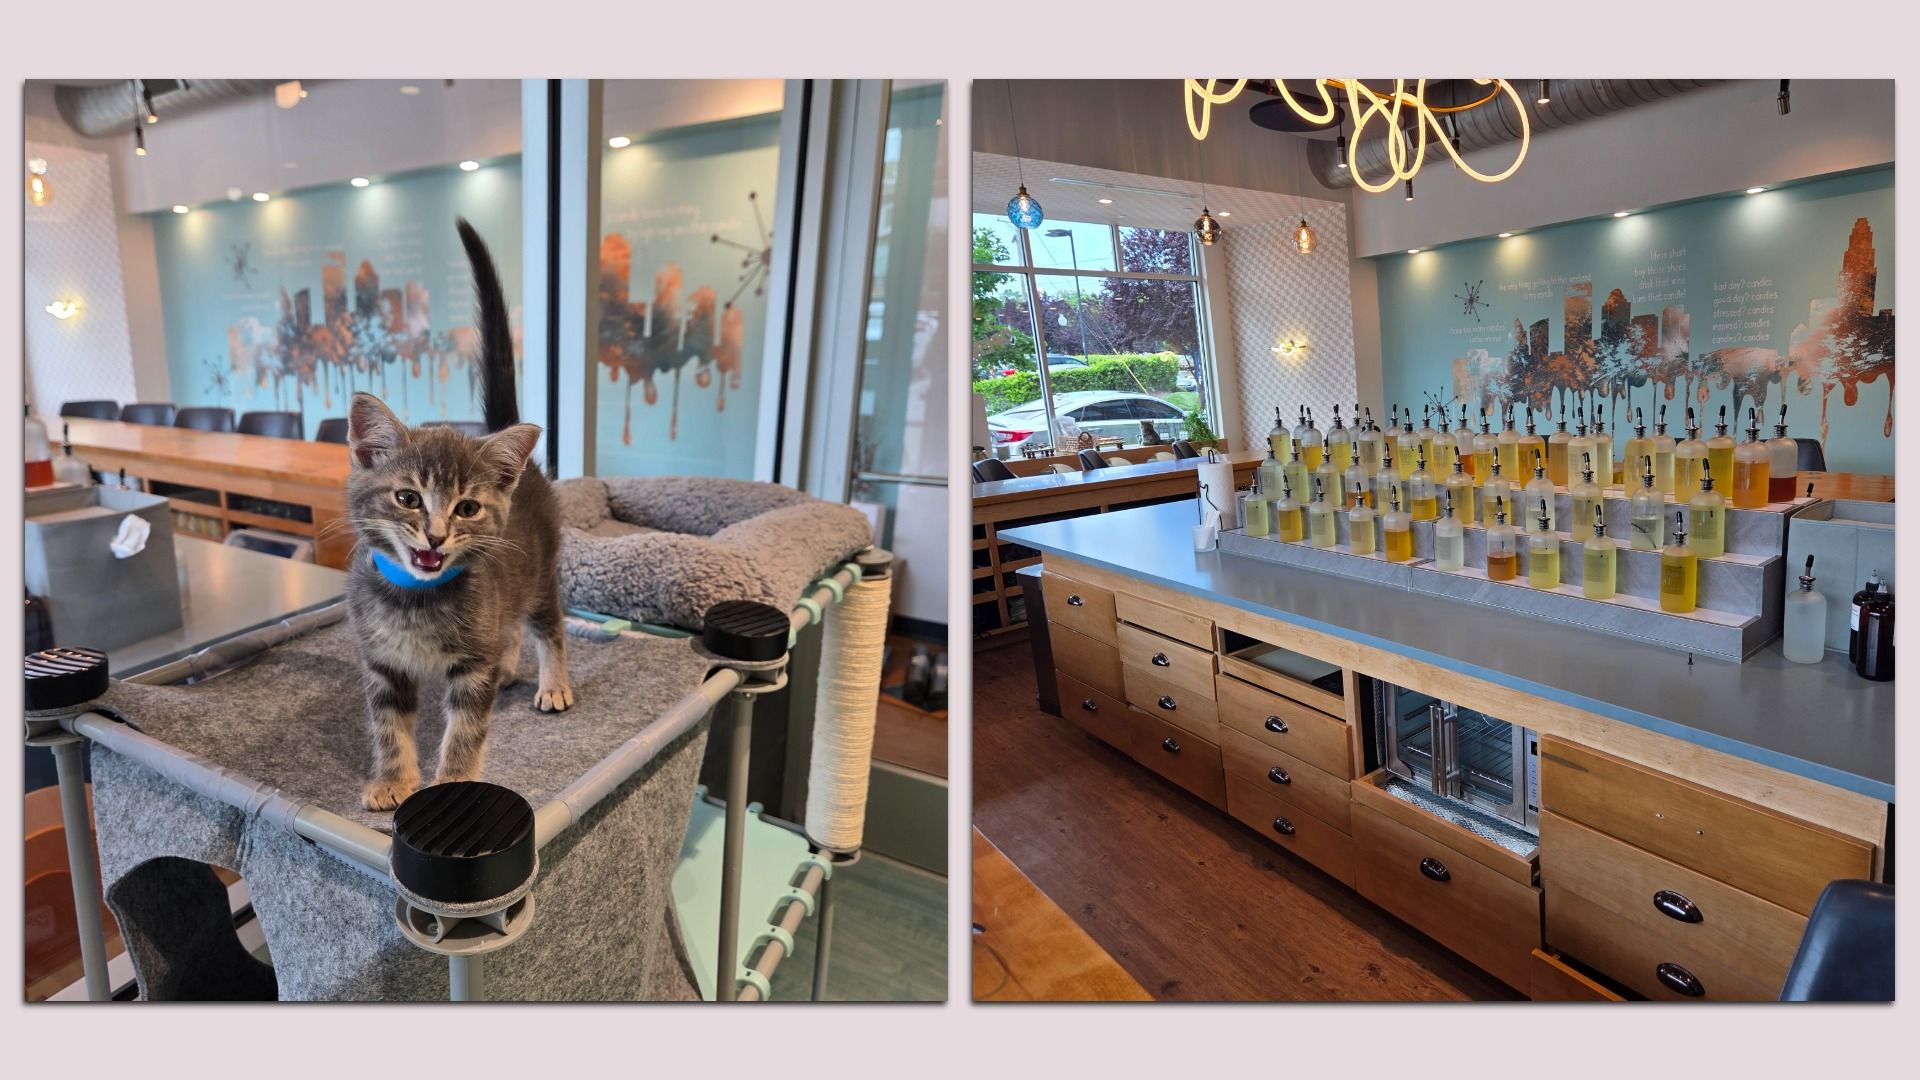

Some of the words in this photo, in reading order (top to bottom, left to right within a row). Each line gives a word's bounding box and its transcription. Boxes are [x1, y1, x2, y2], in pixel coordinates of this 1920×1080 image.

[1669, 247, 1686, 259] short
[1667, 261, 1687, 273] shoes
[1728, 278, 1746, 292] day?
[1746, 275, 1774, 288] candles
[1713, 294, 1731, 309] good
[1732, 291, 1750, 306] day?
[1751, 290, 1778, 302] candles
[1713, 304, 1746, 318] stressed?
[1747, 303, 1776, 316] candles
[1712, 319, 1743, 334] inspired?
[1743, 318, 1770, 330] candles
[1712, 332, 1743, 345] candles?
[1743, 331, 1770, 344] candles
